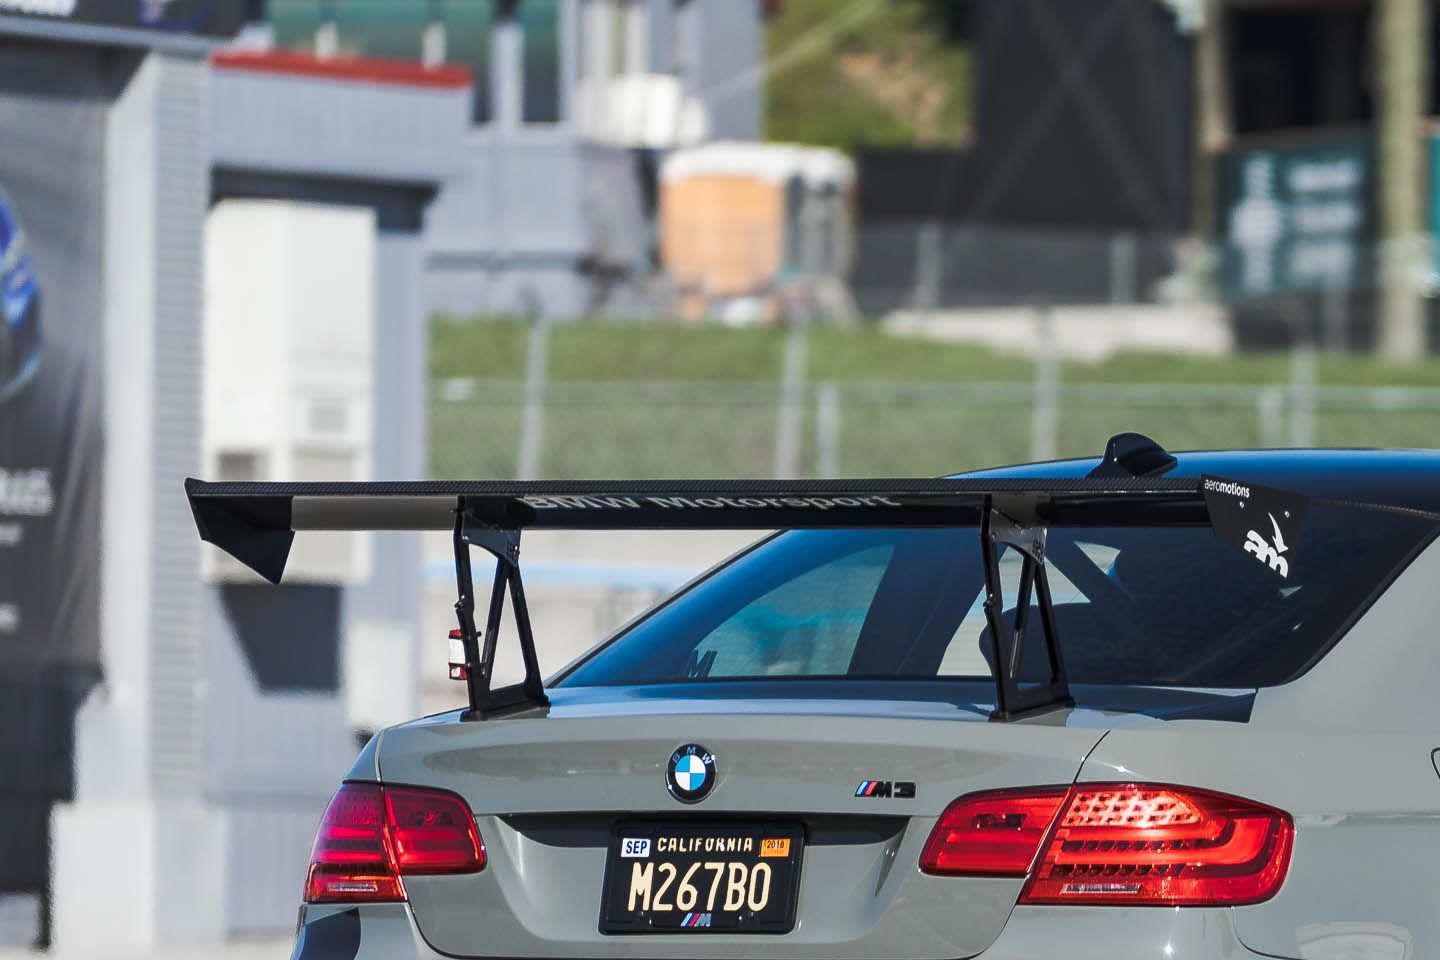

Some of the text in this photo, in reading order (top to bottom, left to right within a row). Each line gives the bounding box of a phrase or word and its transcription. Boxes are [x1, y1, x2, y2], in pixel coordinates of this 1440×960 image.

[1204, 479, 1250, 498] aeromotions
[645, 495, 902, 510] Motorsport
[626, 840, 648, 854] SEP
[657, 837, 753, 852] CALIFORNIA
